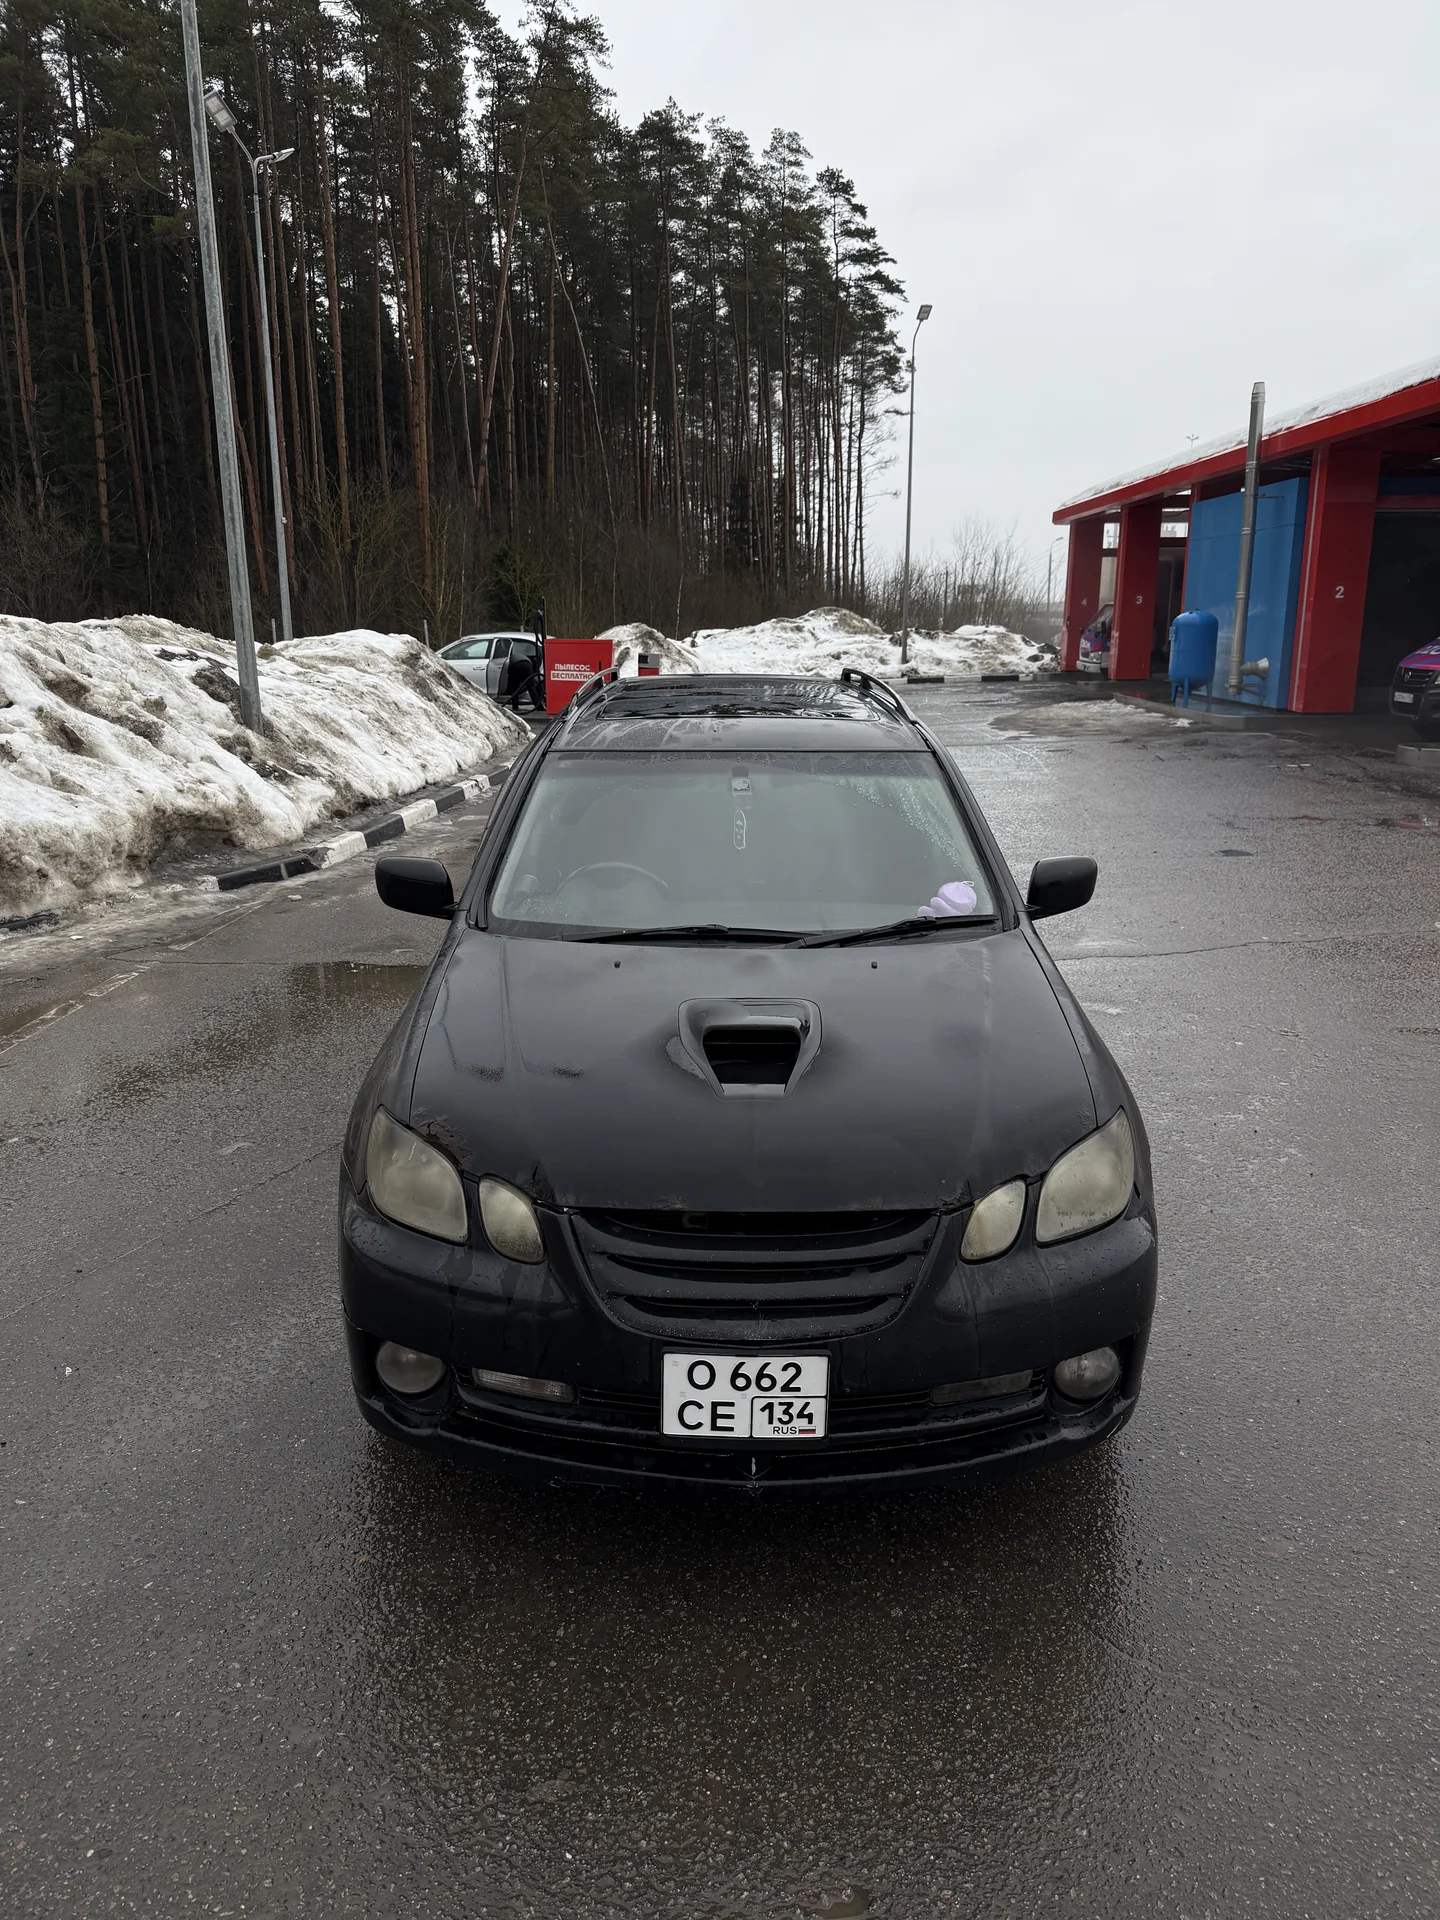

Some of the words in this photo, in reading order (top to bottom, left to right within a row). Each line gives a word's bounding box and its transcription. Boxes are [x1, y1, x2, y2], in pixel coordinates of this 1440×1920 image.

[1335, 585, 1344, 598] 2
[1081, 598, 1087, 606] 4
[1136, 596, 1143, 604] 3
[554, 663, 591, 671] ПЫЛЕСОС
[551, 672, 593, 680] БЕСПЛАТНО
[730, 1361, 802, 1392] 662
[759, 1401, 814, 1425] 134
[772, 1426, 797, 1435] RUS
